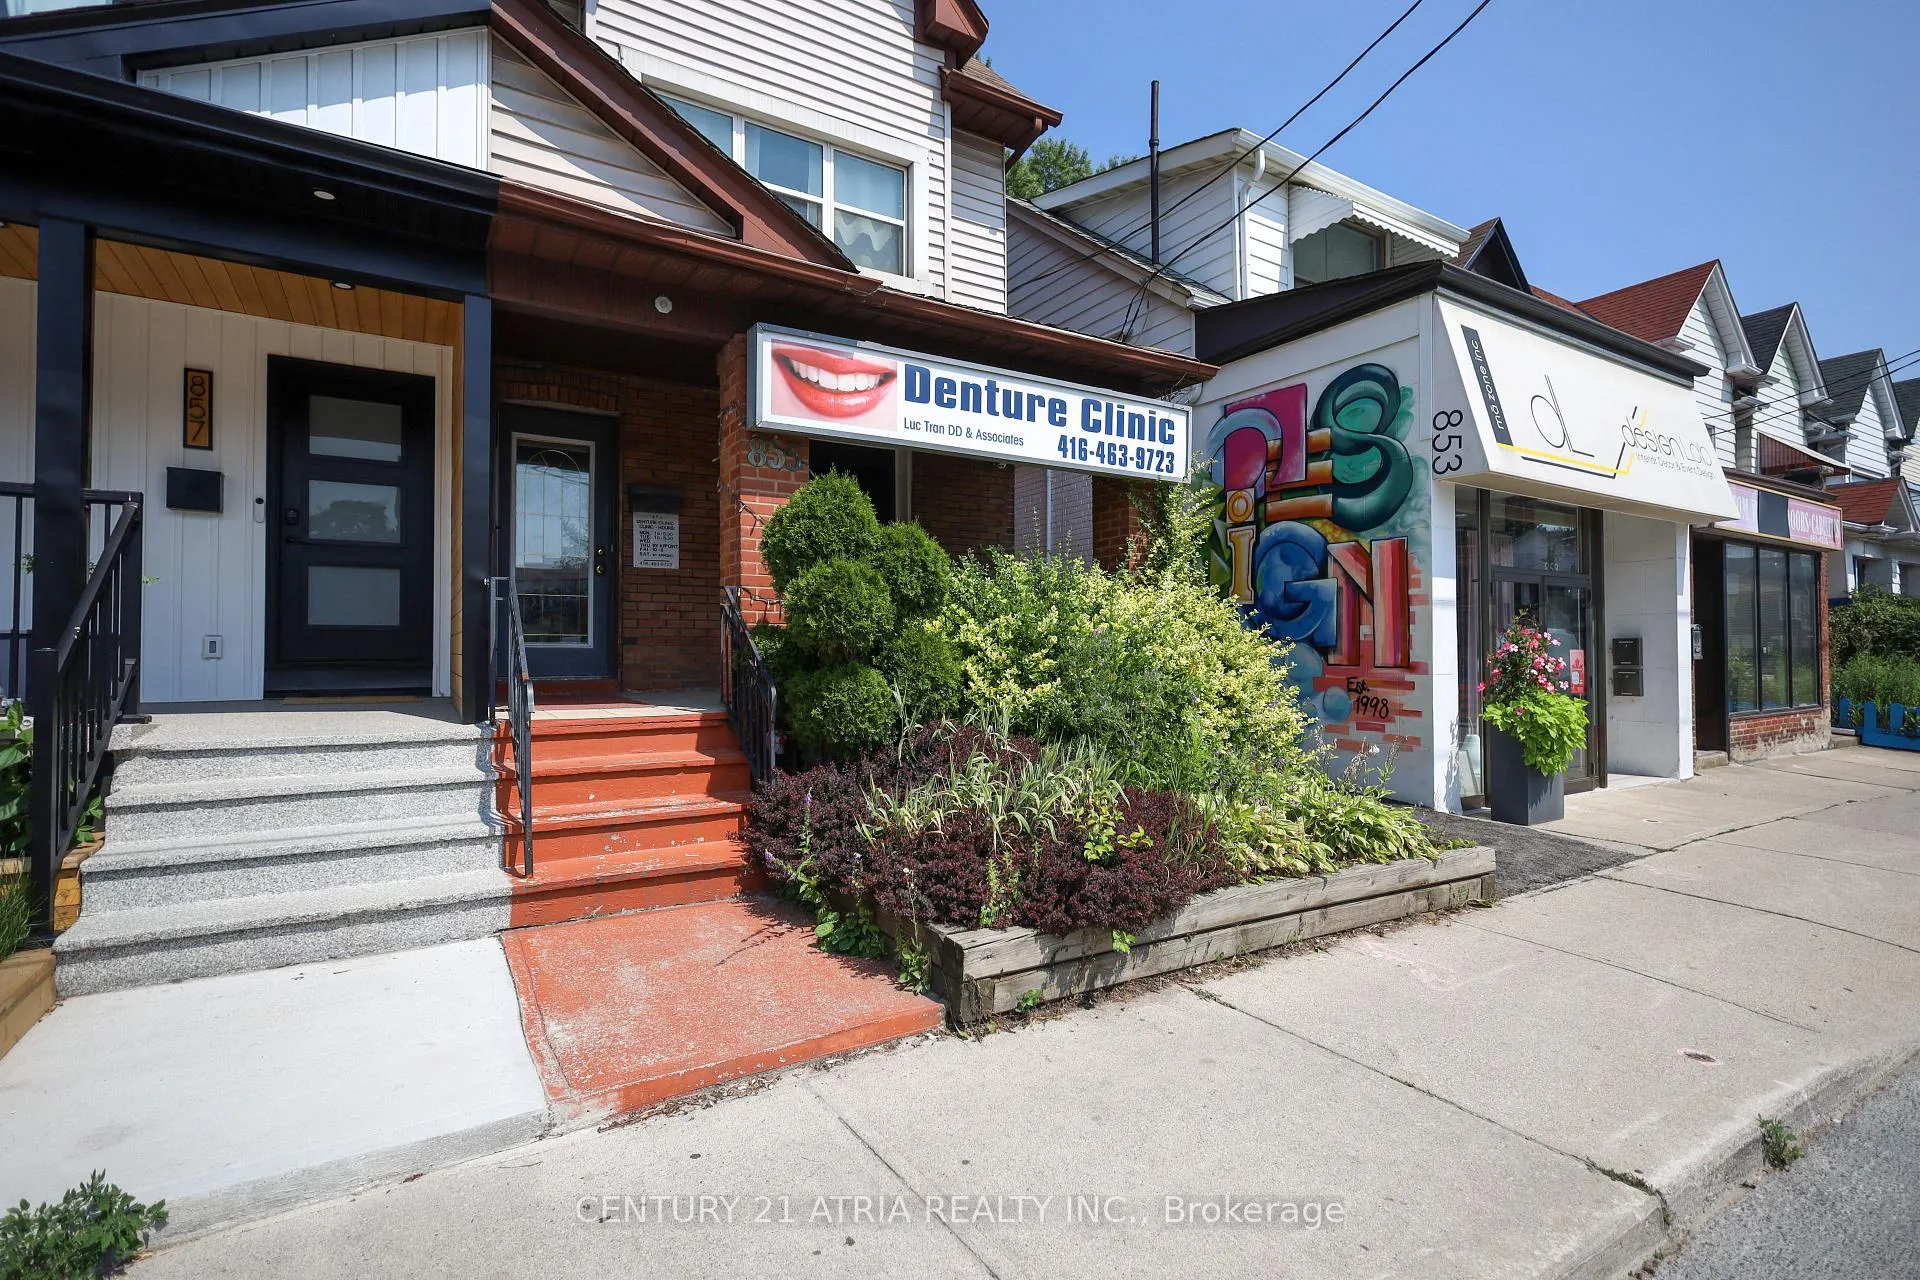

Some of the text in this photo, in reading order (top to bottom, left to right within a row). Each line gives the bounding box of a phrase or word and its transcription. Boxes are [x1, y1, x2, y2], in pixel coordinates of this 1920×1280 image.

[1472, 339, 1483, 362] inc
[1479, 366, 1496, 402] zone
[189, 375, 206, 441] 857
[905, 364, 1175, 445] Denture Clinic
[904, 417, 1024, 446] Luc Tran DD & Associates
[1432, 409, 1463, 475] 853
[1058, 434, 1175, 474] 416-463-9723
[1346, 676, 1370, 694] Est.
[1353, 695, 1389, 719] 1998
